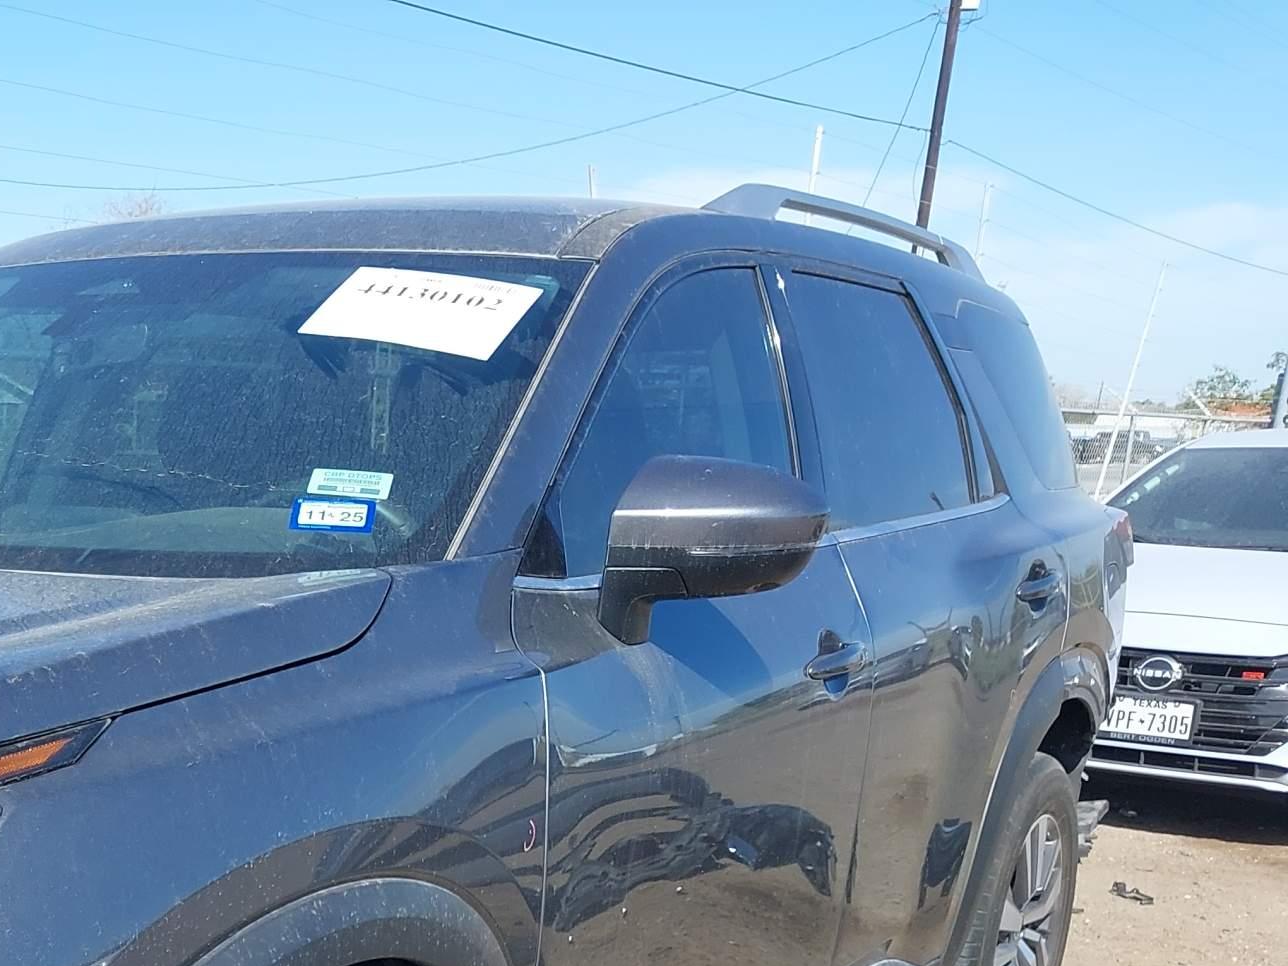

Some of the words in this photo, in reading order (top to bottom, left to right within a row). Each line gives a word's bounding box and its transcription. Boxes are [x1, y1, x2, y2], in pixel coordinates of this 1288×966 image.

[357, 283, 503, 311] 44130102
[306, 510, 325, 521] 11
[339, 511, 364, 523] 25
[1133, 667, 1182, 680] NISSAN
[1132, 697, 1168, 710] TEXAS
